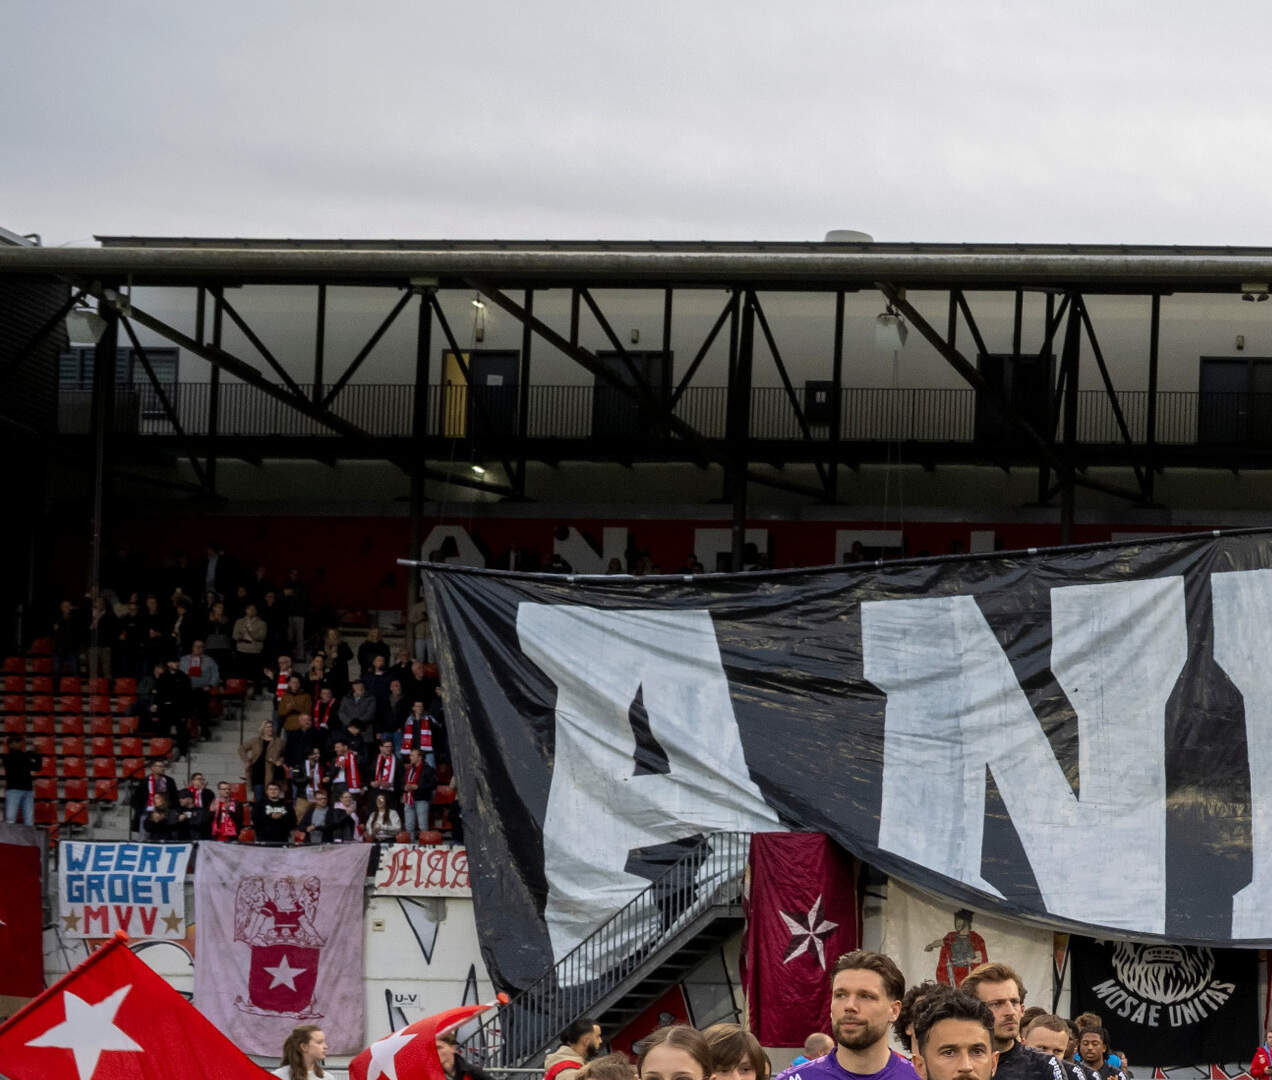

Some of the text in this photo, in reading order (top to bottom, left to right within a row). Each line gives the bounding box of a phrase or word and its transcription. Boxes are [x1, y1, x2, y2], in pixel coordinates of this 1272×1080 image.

[65, 843, 187, 873] WEERT
[66, 873, 176, 904] GROET
[83, 905, 158, 935] MVV
[394, 994, 418, 1003] U-V
[1092, 977, 1237, 1027] MOSAE UNITAS
